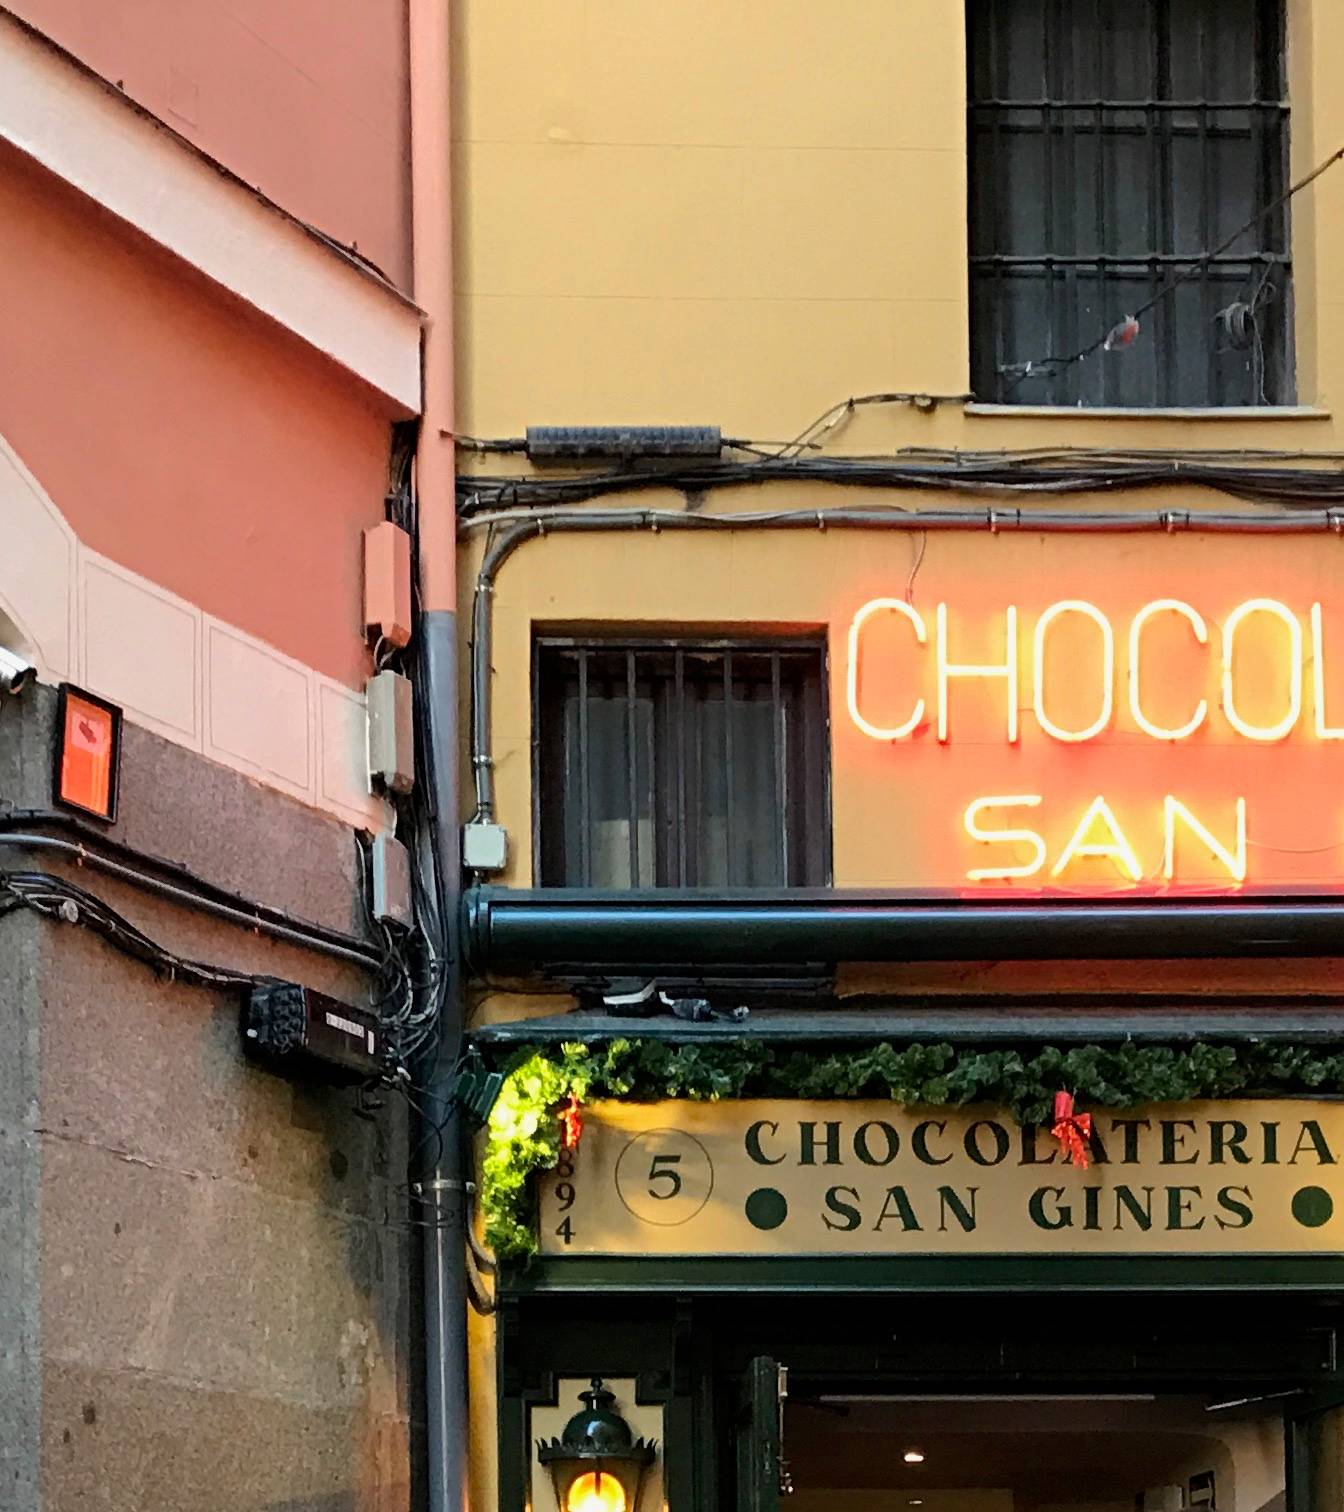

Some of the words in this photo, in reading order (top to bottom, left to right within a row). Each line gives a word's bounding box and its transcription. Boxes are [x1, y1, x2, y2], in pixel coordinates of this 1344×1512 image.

[963, 793, 1248, 882] SAN
[744, 1119, 1338, 1166] CHOCOLATERIA
[554, 1149, 576, 1245] 894
[648, 1154, 682, 1200] 5
[821, 1184, 979, 1232] SAN
[1027, 1184, 1255, 1232] GINES
